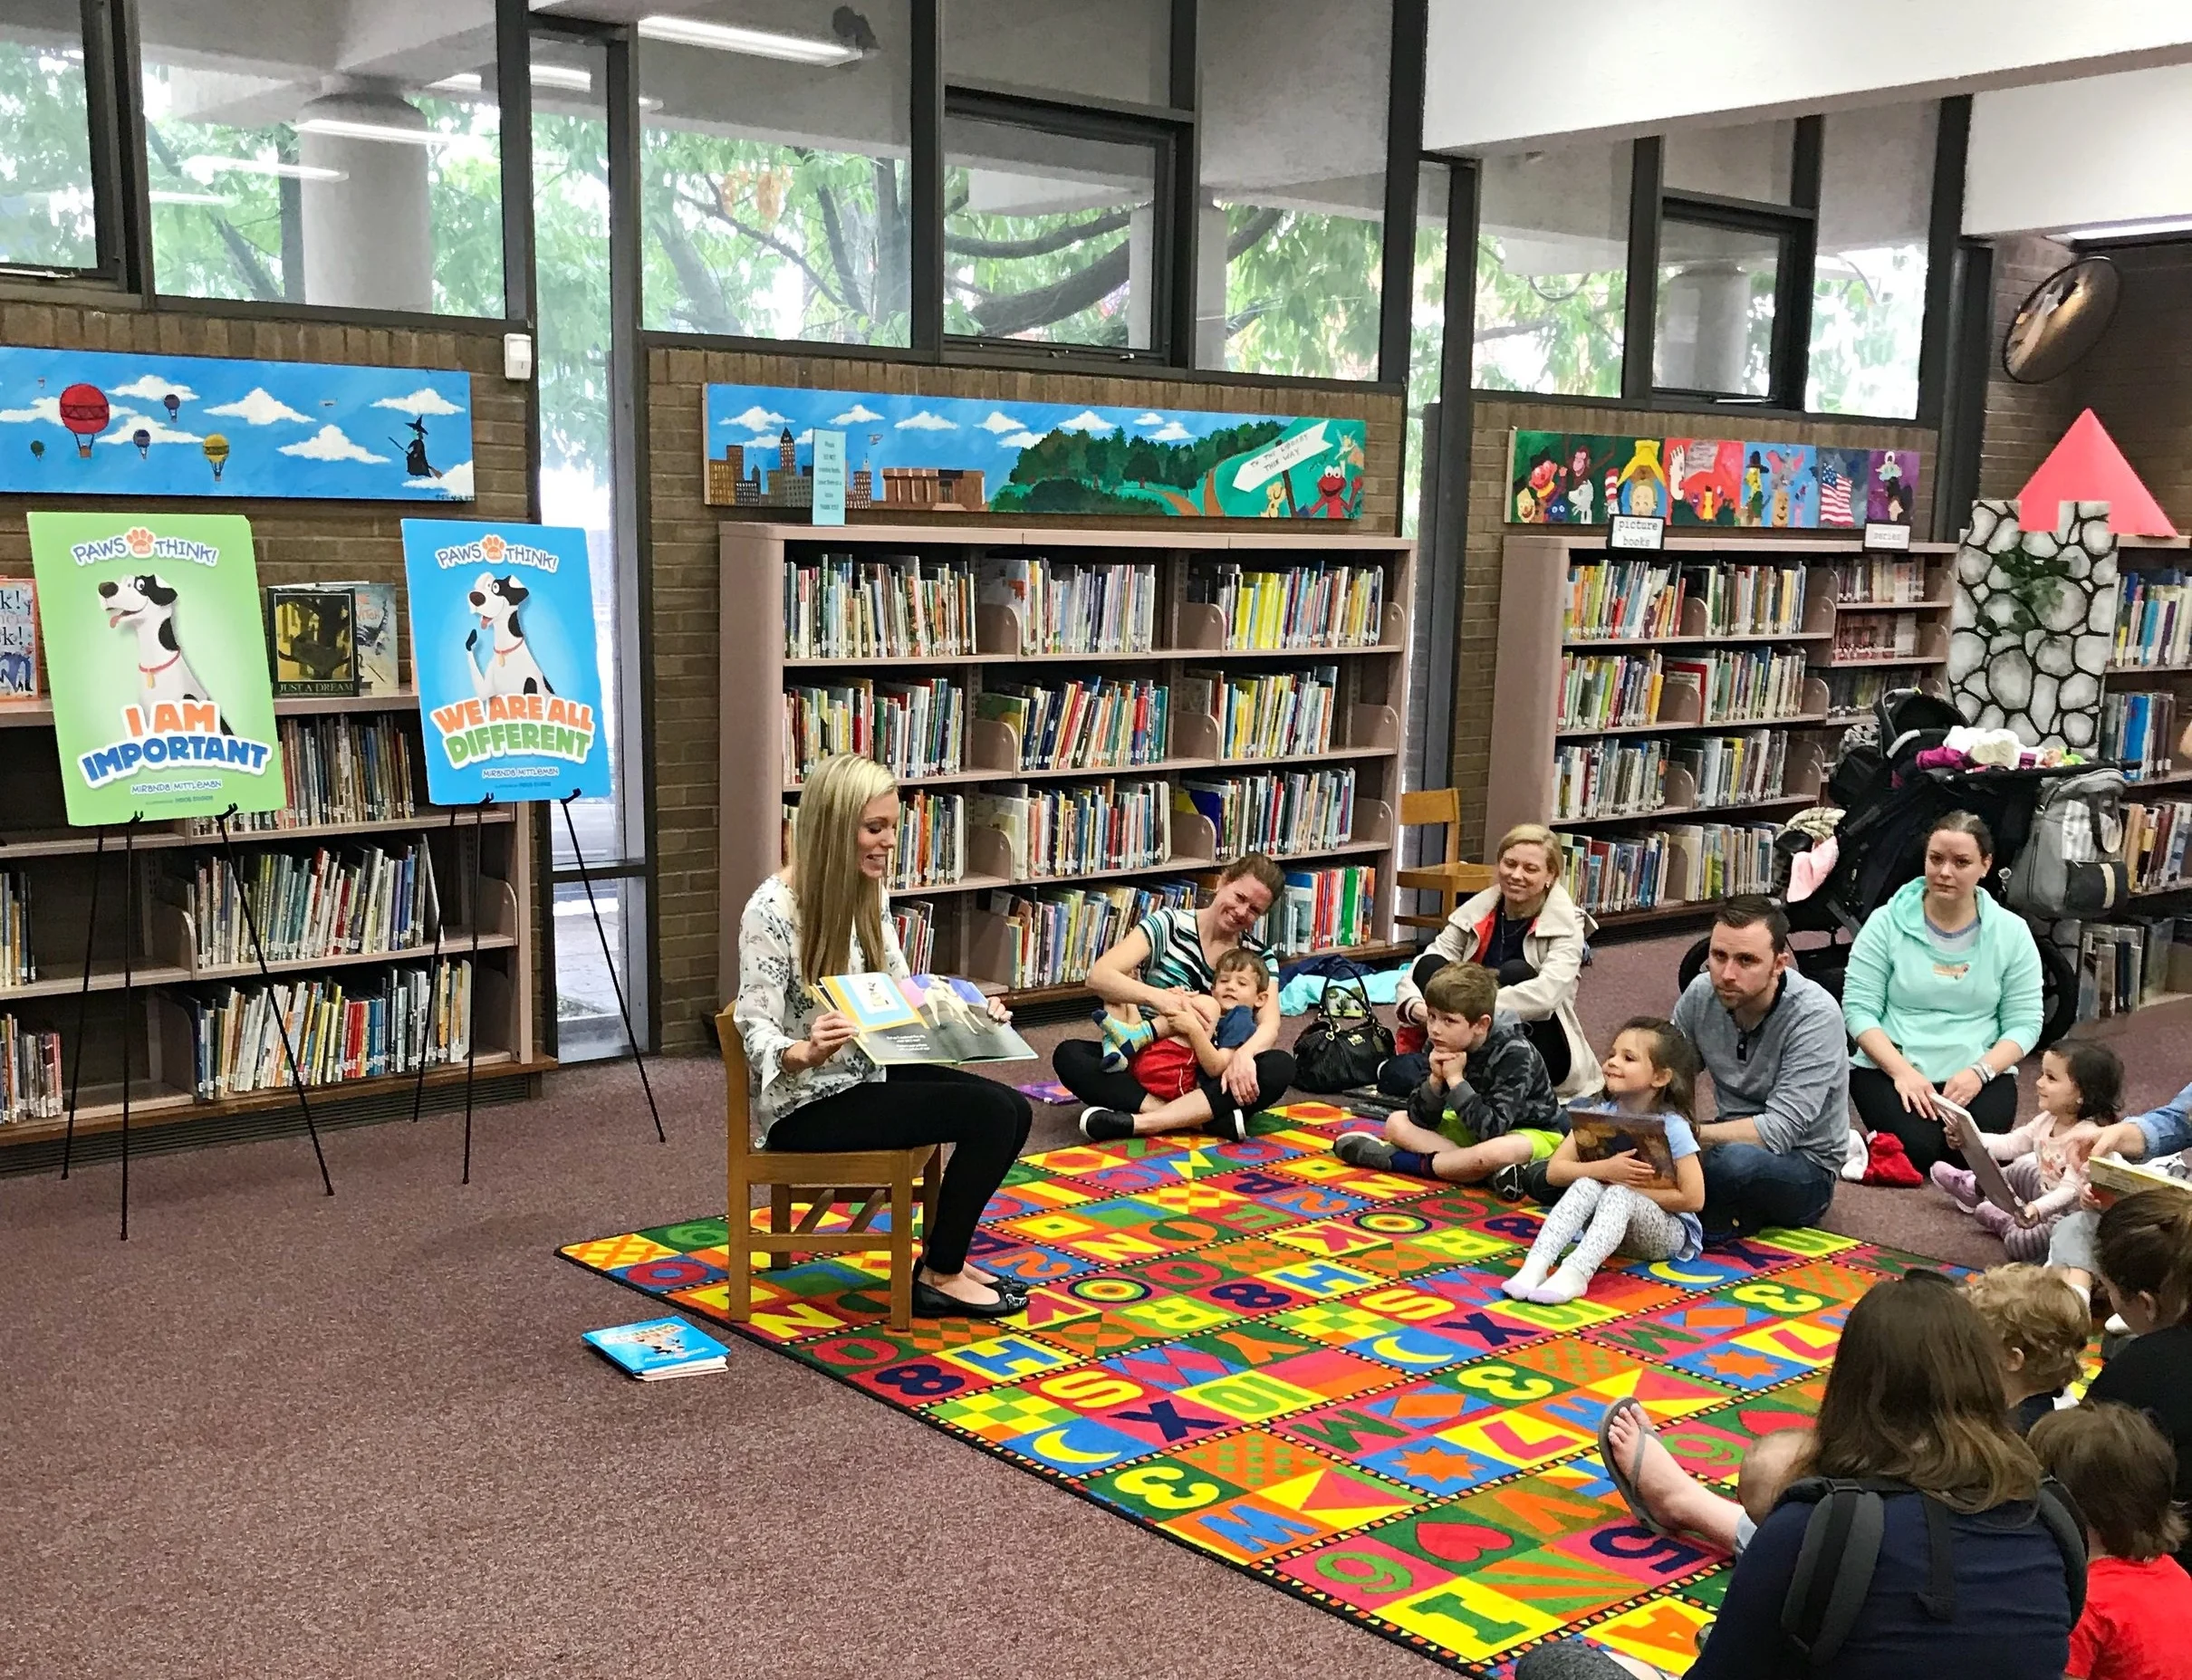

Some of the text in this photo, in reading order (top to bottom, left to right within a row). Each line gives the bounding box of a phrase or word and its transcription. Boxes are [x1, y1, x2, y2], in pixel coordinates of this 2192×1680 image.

[1283, 447, 1300, 461] WAY
[1618, 520, 1658, 532] picture
[73, 536, 128, 563] PAWS
[156, 541, 217, 564] THINK!
[1622, 535, 1651, 547] books
[437, 543, 482, 565] PAWS
[506, 547, 558, 570] THINK!
[279, 683, 354, 692] JUST A DREAM
[125, 703, 216, 737] I AM
[433, 696, 593, 734] WE ARE ALL
[446, 724, 591, 764] DIFFERENT
[82, 735, 268, 782] IMPORTANT
[1279, 1265, 1365, 1292] H
[1361, 1291, 1454, 1319] S
[1734, 1285, 1822, 1311] 3
[959, 1340, 1055, 1375] H
[1042, 1372, 1141, 1406] S
[1458, 1367, 1553, 1399] 3
[1115, 1467, 1218, 1509] 3
